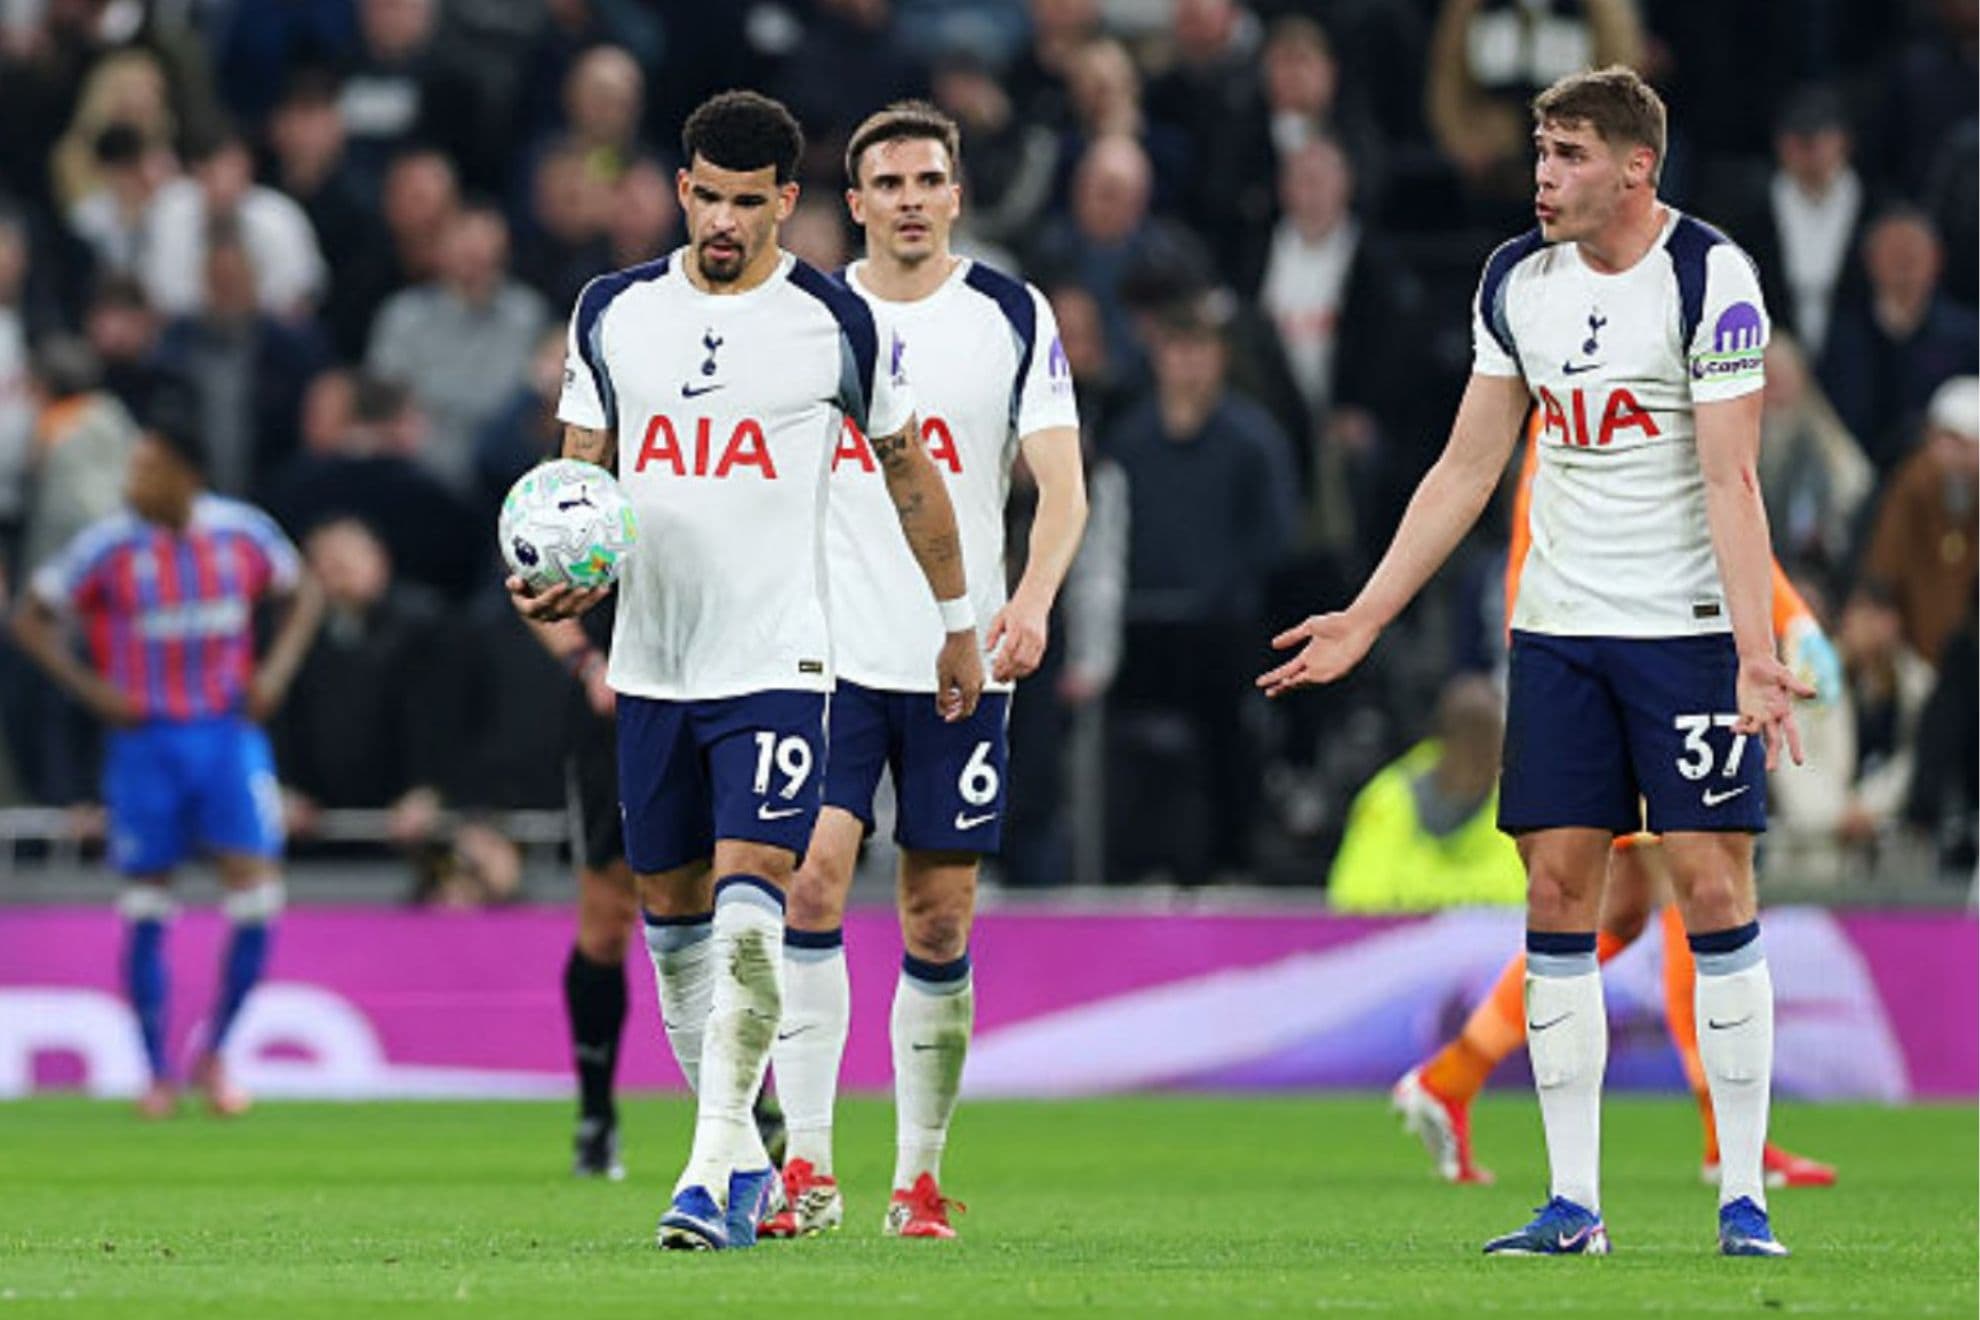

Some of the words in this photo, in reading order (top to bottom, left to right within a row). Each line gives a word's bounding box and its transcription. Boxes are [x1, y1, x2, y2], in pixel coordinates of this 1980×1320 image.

[635, 414, 776, 478] AIA
[831, 415, 962, 473] AA
[1540, 385, 1660, 446] AIA
[751, 731, 813, 800] 19
[958, 741, 999, 806] 6
[1674, 714, 1748, 780] 37
